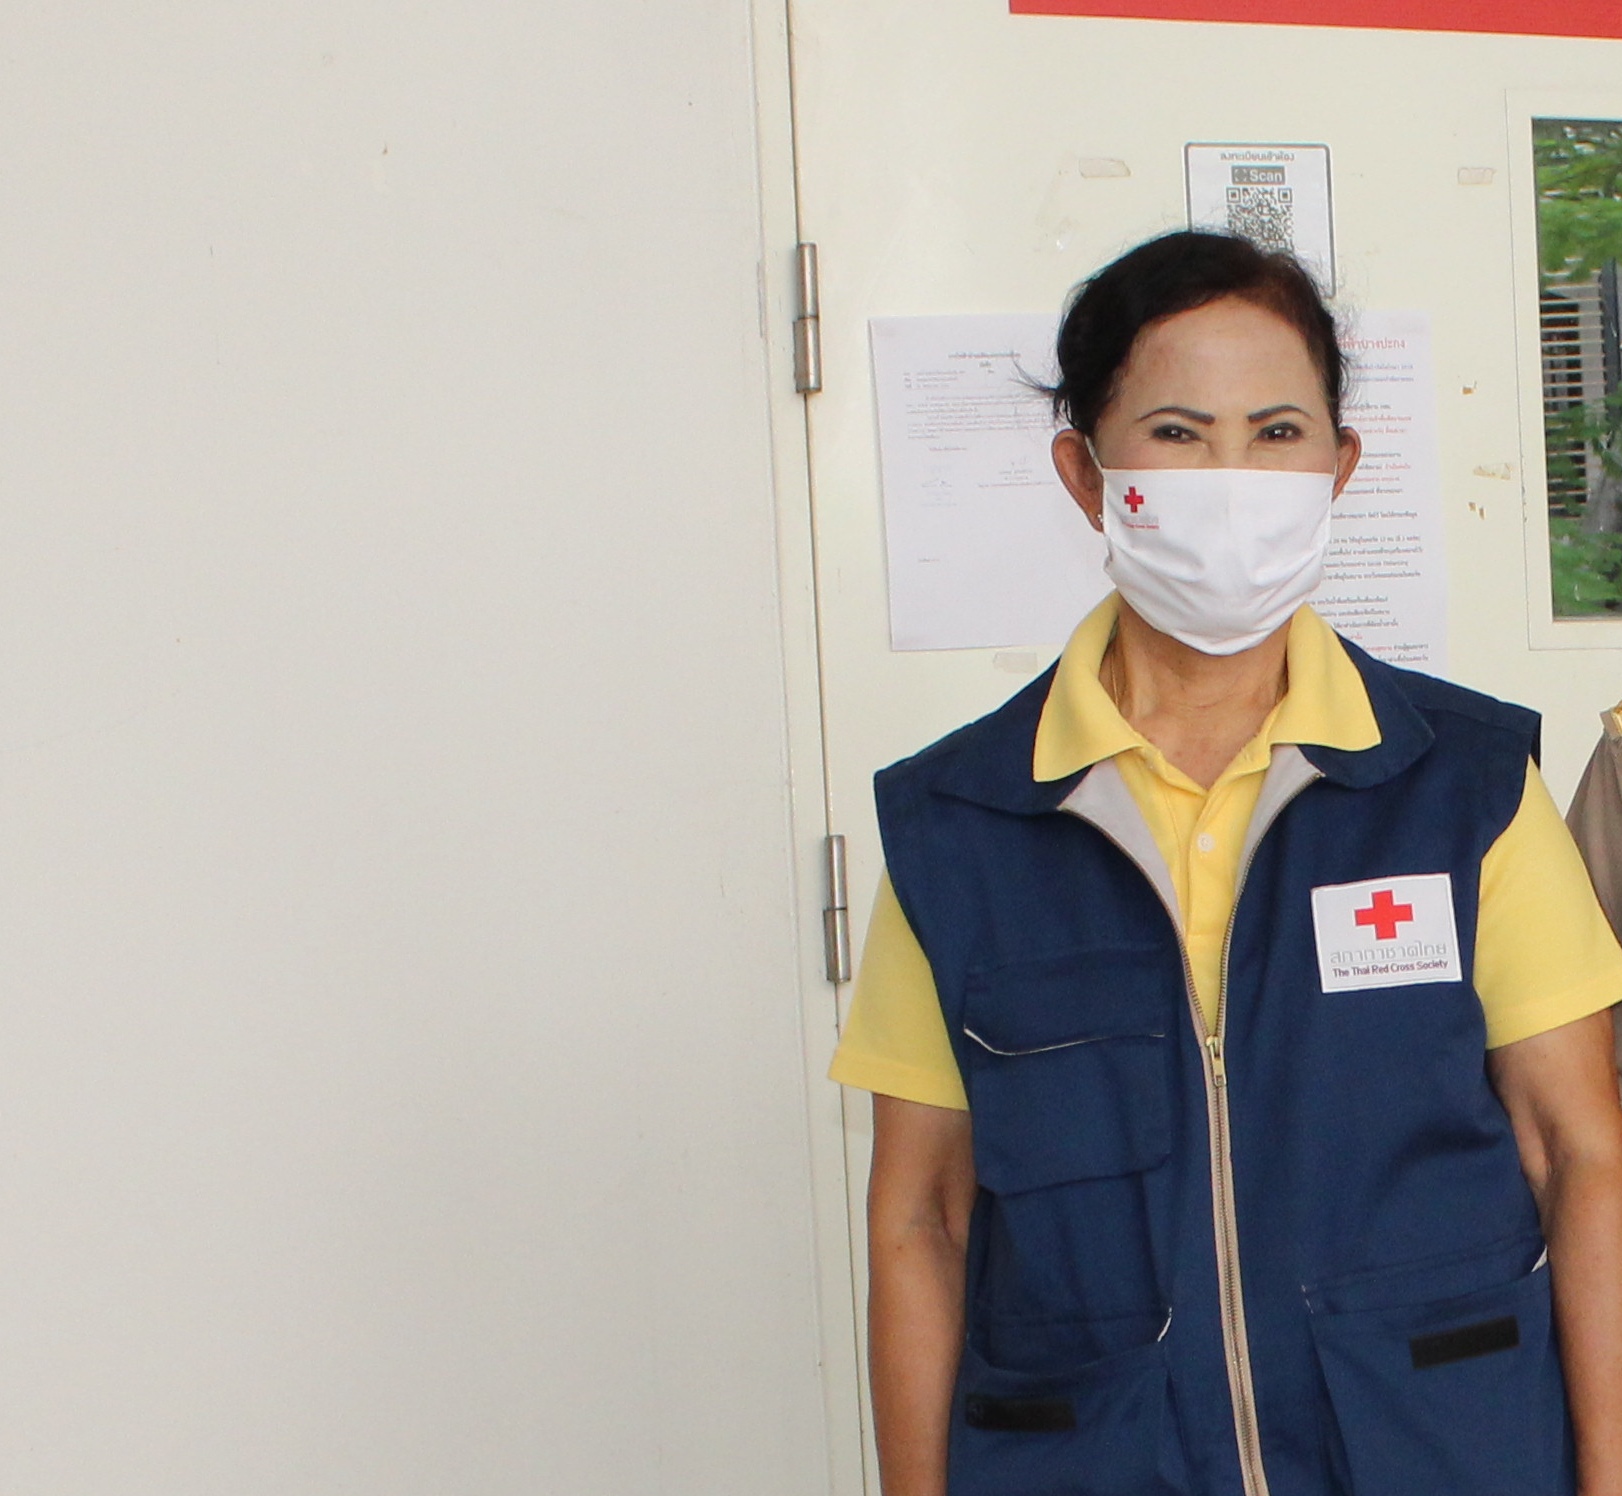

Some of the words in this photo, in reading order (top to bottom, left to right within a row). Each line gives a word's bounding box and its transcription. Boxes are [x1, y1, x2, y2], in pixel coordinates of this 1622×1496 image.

[1249, 168, 1283, 182] Scan
[1330, 940, 1447, 964] สภากาชาดไทย
[1333, 967, 1350, 978] The
[1351, 965, 1371, 976] Thai
[1371, 964, 1389, 975] Red
[1390, 962, 1415, 973] Cross
[1416, 959, 1449, 971] Society
